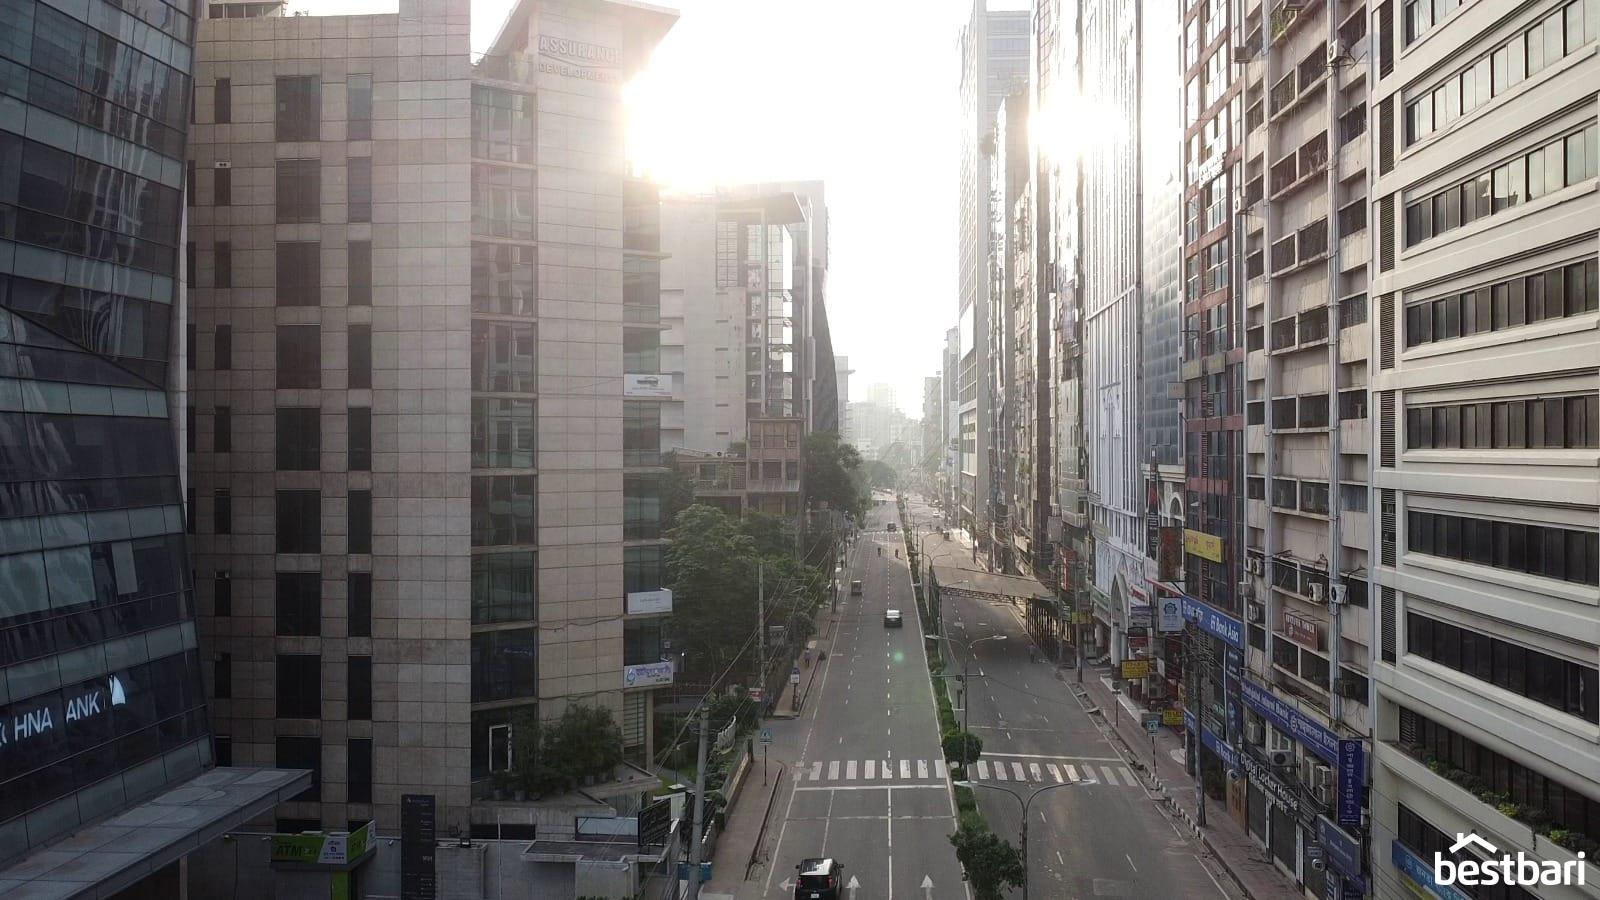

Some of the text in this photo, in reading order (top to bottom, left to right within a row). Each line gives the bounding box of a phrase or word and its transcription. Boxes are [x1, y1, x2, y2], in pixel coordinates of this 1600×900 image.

[539, 36, 621, 64] ASSURANCE
[1216, 617, 1239, 642] Bank Asia
[1276, 702, 1289, 720] Bank
[1241, 753, 1258, 776] Digital
[1258, 767, 1277, 792] Locker
[1278, 784, 1298, 811] House
[276, 845, 302, 857] ATM
